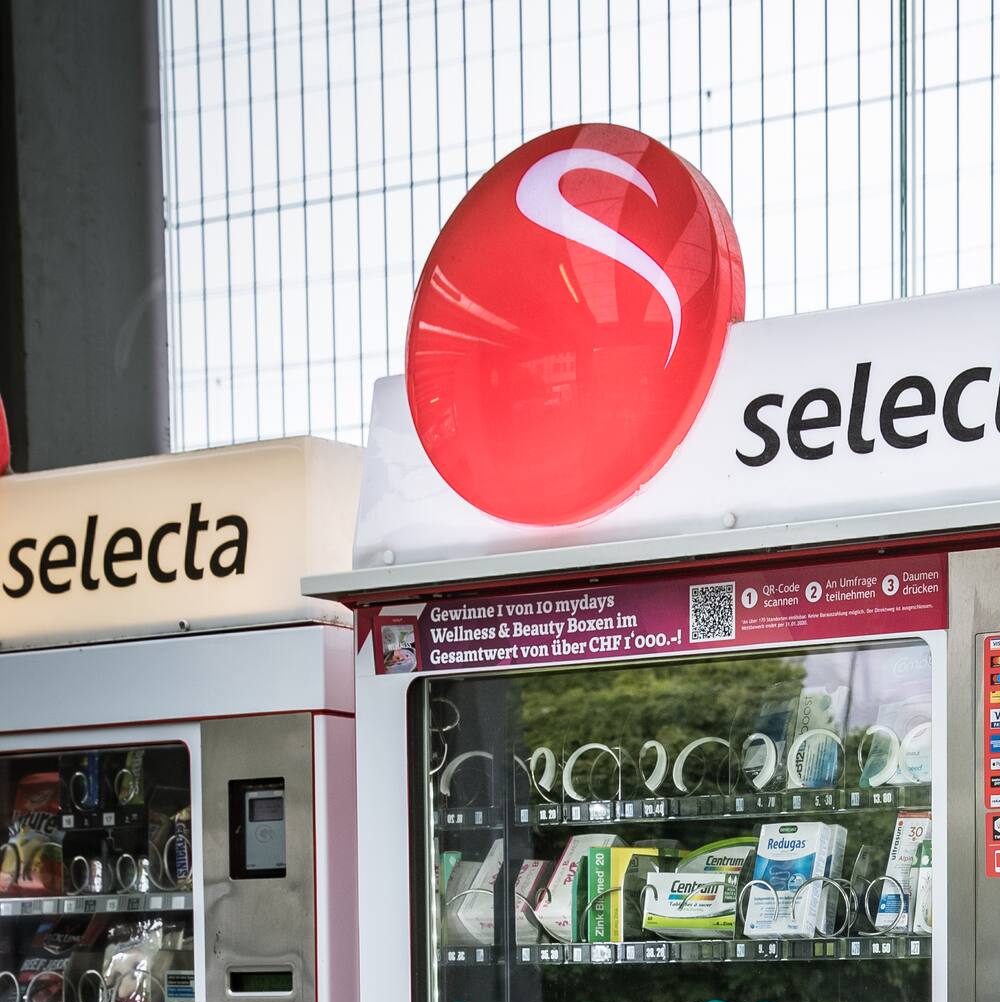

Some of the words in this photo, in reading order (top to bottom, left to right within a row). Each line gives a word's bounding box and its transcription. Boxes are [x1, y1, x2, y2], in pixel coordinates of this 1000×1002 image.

[2, 501, 249, 598] selecta
[902, 570, 939, 582] Daumen
[810, 586, 817, 598] 2
[826, 579, 837, 589] An
[839, 575, 877, 589] Umfrage
[887, 578, 894, 591] 3
[902, 582, 939, 595] drücken
[746, 592, 752, 605] 1
[762, 582, 800, 596] QR-Code
[825, 588, 875, 602] teilnehmen
[430, 606, 495, 622] Gewinne
[505, 603, 533, 616] von
[555, 594, 615, 617] mydays
[763, 596, 798, 608] scannen
[430, 625, 495, 644] Wellness
[498, 623, 510, 639] &
[513, 618, 565, 642] Beauty
[567, 615, 614, 634] Boxen
[616, 612, 637, 628] im
[430, 646, 519, 665] Gesamtwert
[521, 643, 549, 657] von
[552, 638, 586, 655] über
[589, 635, 621, 653] CHF
[908, 826, 924, 838] 30
[767, 838, 806, 851] Redugas
[891, 826, 903, 861] ultrasun
[595, 853, 605, 866] 20
[705, 855, 745, 866] Centrum
[595, 914, 605, 937] Zink
